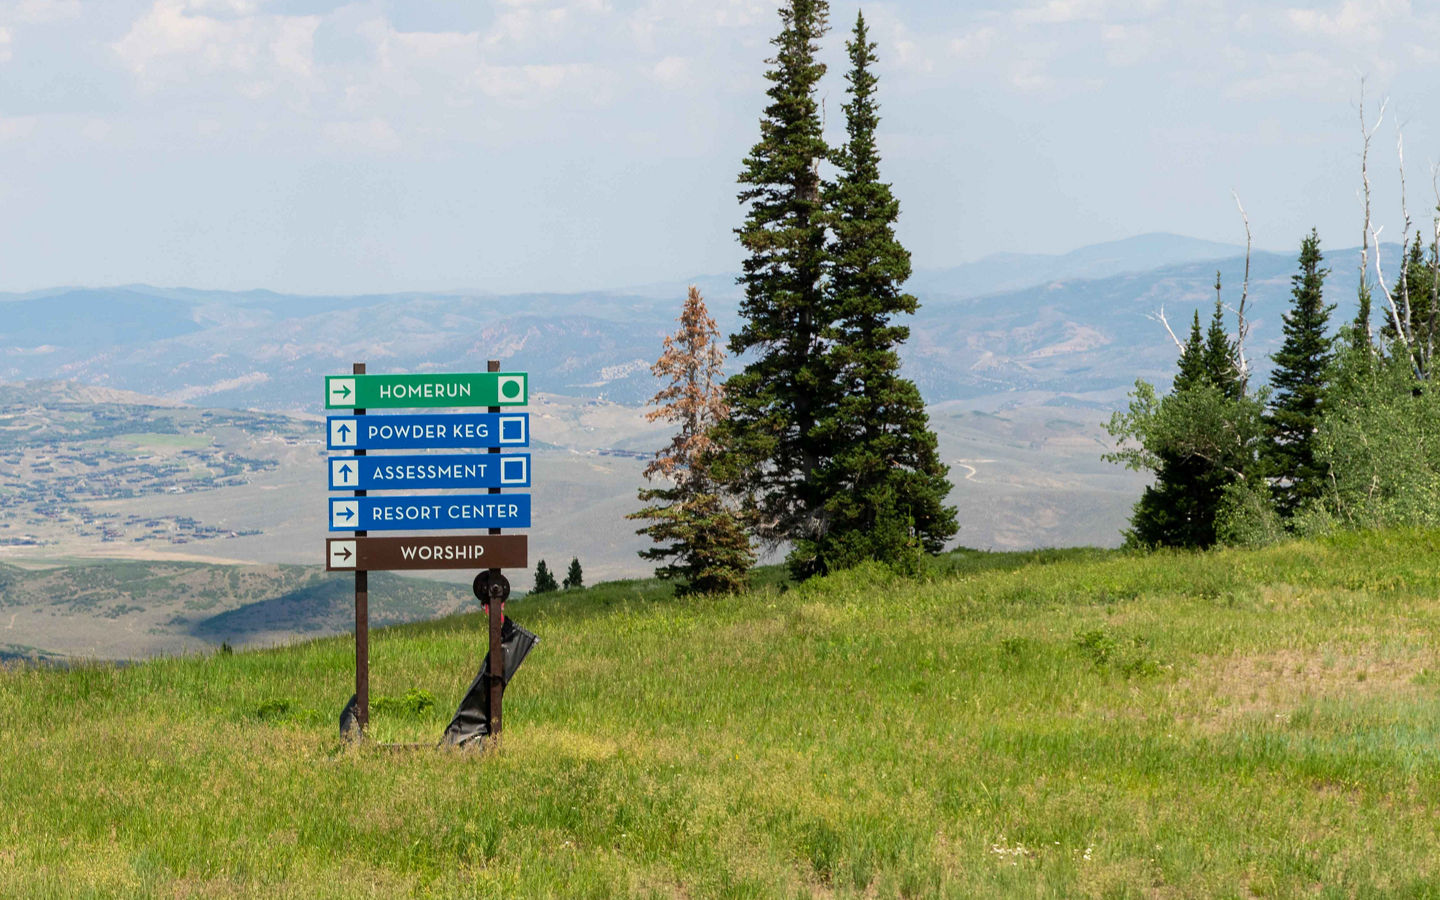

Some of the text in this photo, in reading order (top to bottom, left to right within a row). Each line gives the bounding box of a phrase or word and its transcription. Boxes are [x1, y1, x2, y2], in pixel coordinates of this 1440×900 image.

[379, 383, 471, 398] HOMERUN
[368, 424, 489, 440] POWDER KEG
[373, 464, 488, 480] ASSESSMENT
[372, 504, 519, 521] RESORT CENTER
[400, 545, 485, 560] WORSHIP
